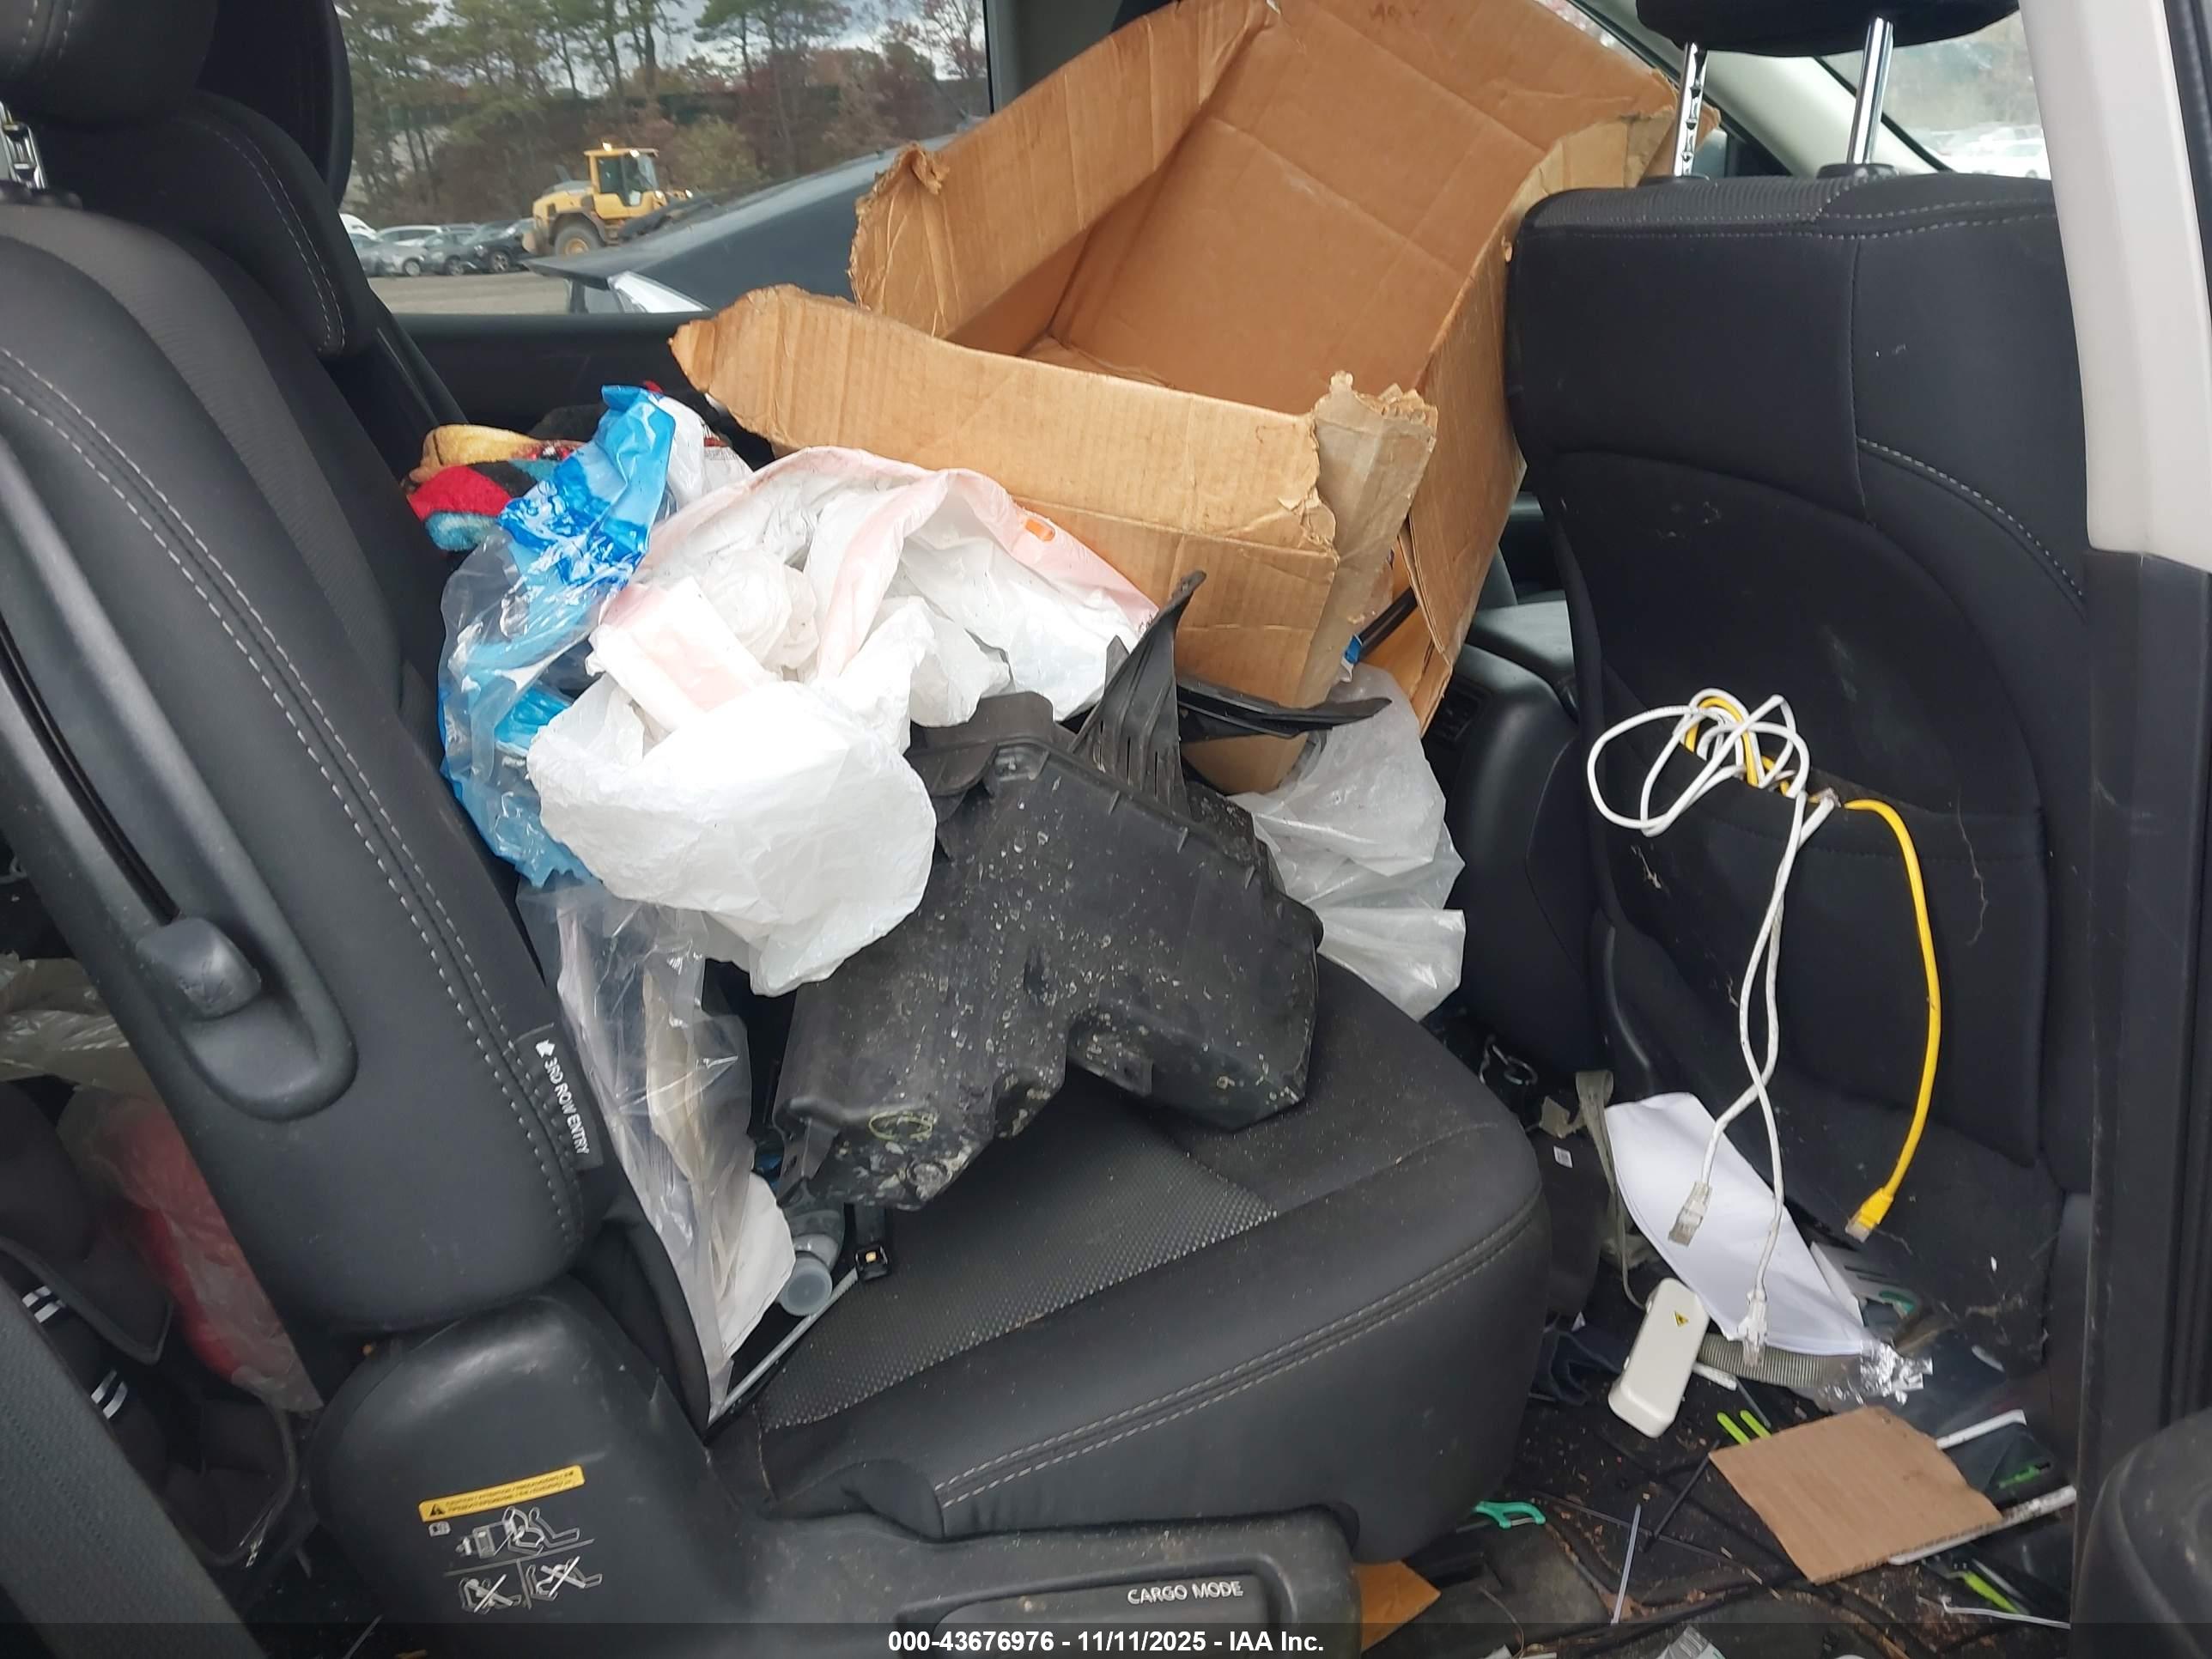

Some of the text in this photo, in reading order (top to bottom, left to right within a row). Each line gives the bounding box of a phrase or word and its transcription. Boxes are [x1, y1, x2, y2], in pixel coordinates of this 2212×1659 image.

[544, 1056, 590, 1154] 3RD ROW ENTRY
[1127, 1581, 1244, 1605] CARGO MODE
